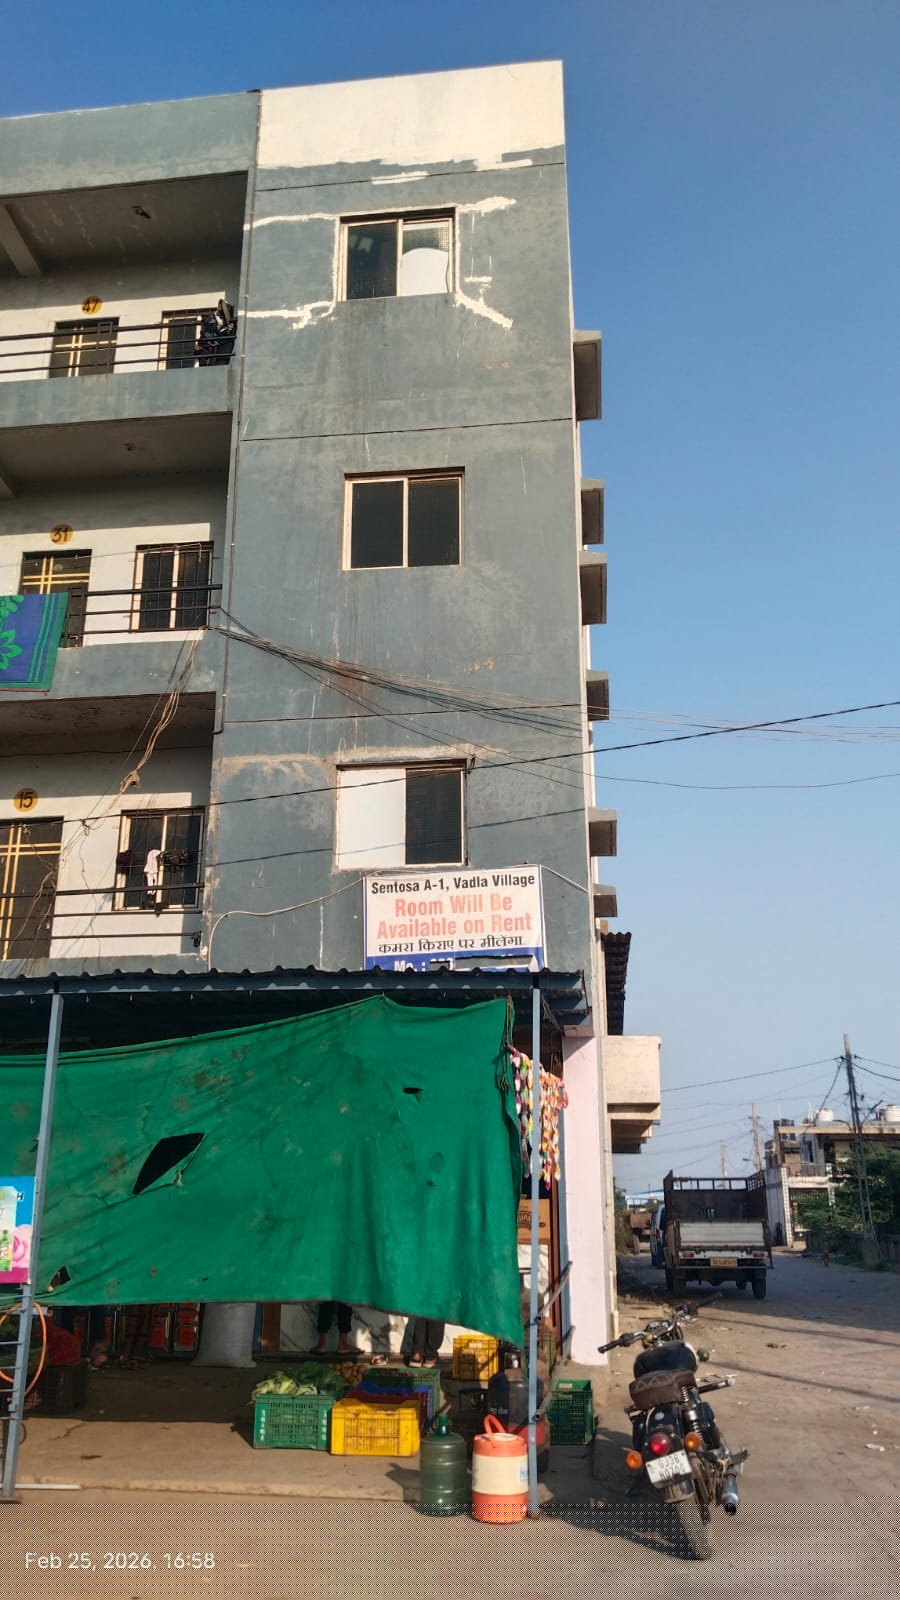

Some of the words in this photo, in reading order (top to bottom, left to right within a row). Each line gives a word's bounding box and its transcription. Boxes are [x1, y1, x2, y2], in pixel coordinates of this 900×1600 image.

[82, 298, 100, 312] 47
[51, 527, 69, 543] 31
[19, 791, 34, 808] 15
[371, 881, 420, 894] Sentosa
[423, 879, 450, 893] A-1,
[453, 876, 488, 889] Vadla
[492, 874, 535, 889] Village
[395, 898, 443, 917] Room
[449, 894, 483, 913] Will
[490, 893, 513, 912] Be
[376, 917, 457, 939] Available
[463, 919, 485, 933] on
[491, 912, 533, 932] Rent
[378, 941, 414, 954] कमरा
[418, 939, 454, 952] किराए
[458, 938, 475, 949] पर
[658, 1455, 680, 1469] GJ36
